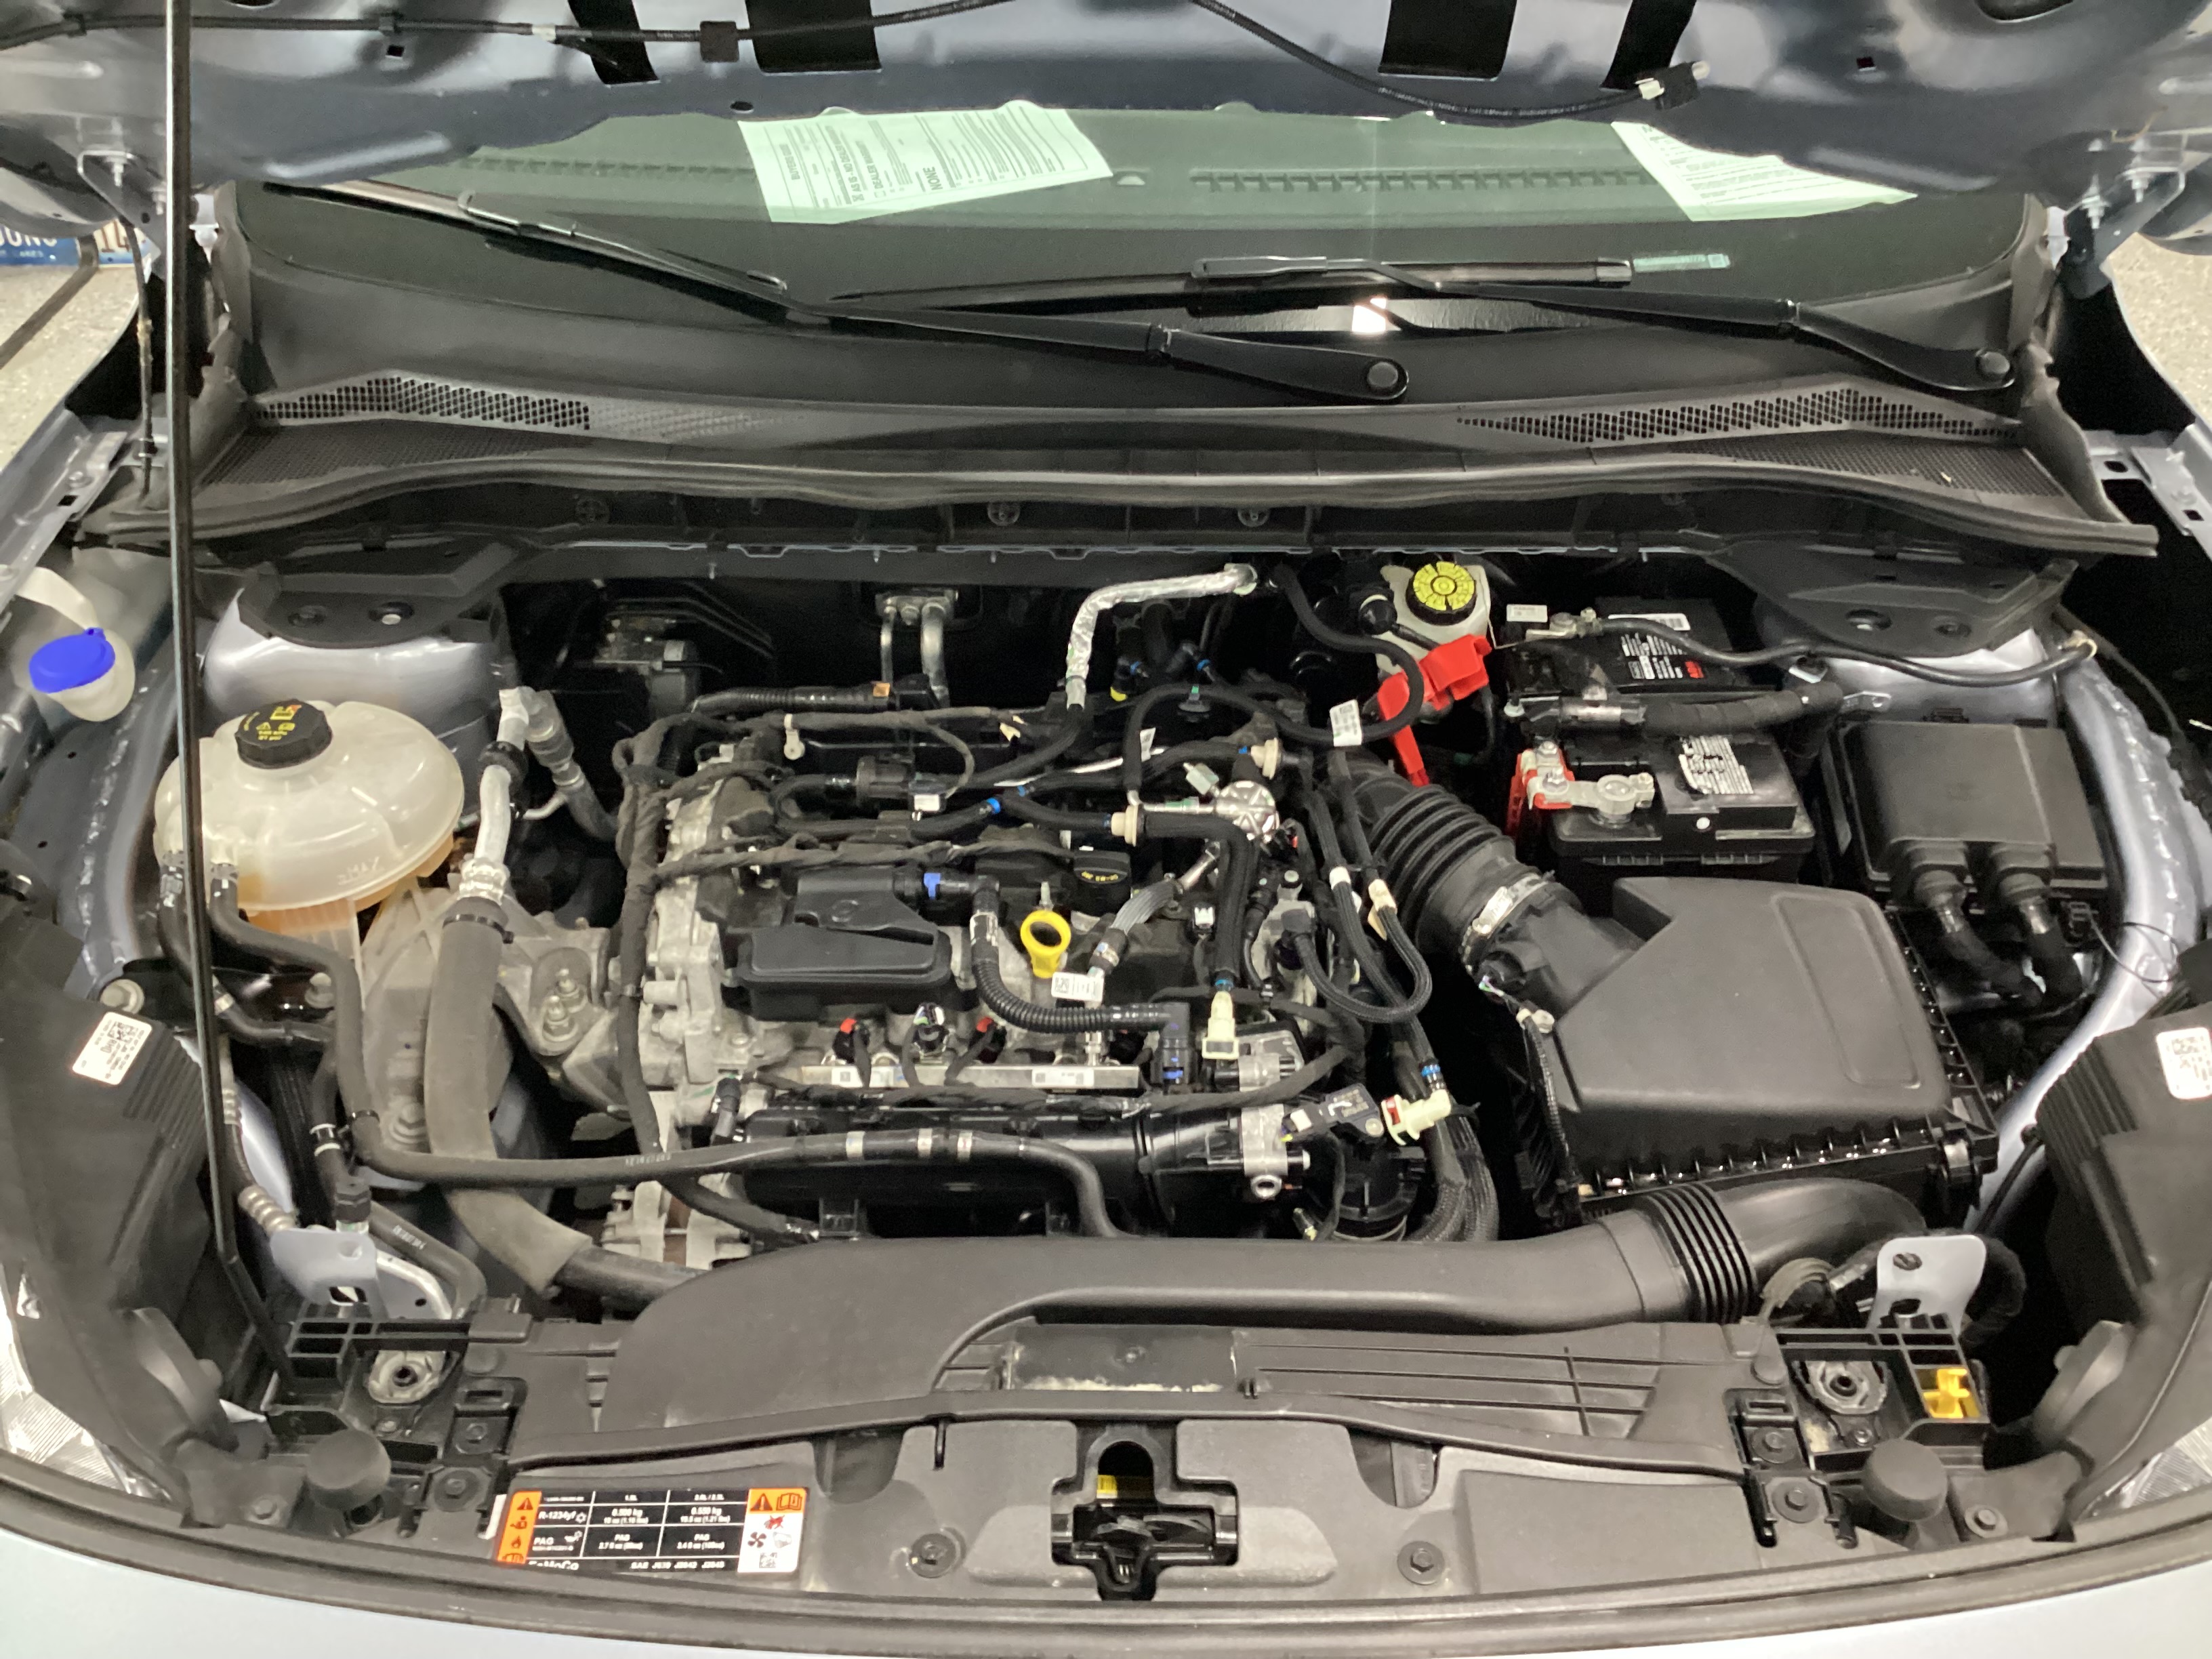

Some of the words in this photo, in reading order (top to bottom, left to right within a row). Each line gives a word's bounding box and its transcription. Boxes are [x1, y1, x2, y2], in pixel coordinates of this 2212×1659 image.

[867, 164, 884, 189] DEALER
[922, 166, 943, 190] NONE
[538, 1511, 577, 1521] R-1234yf
[533, 1537, 554, 1545] PAG
